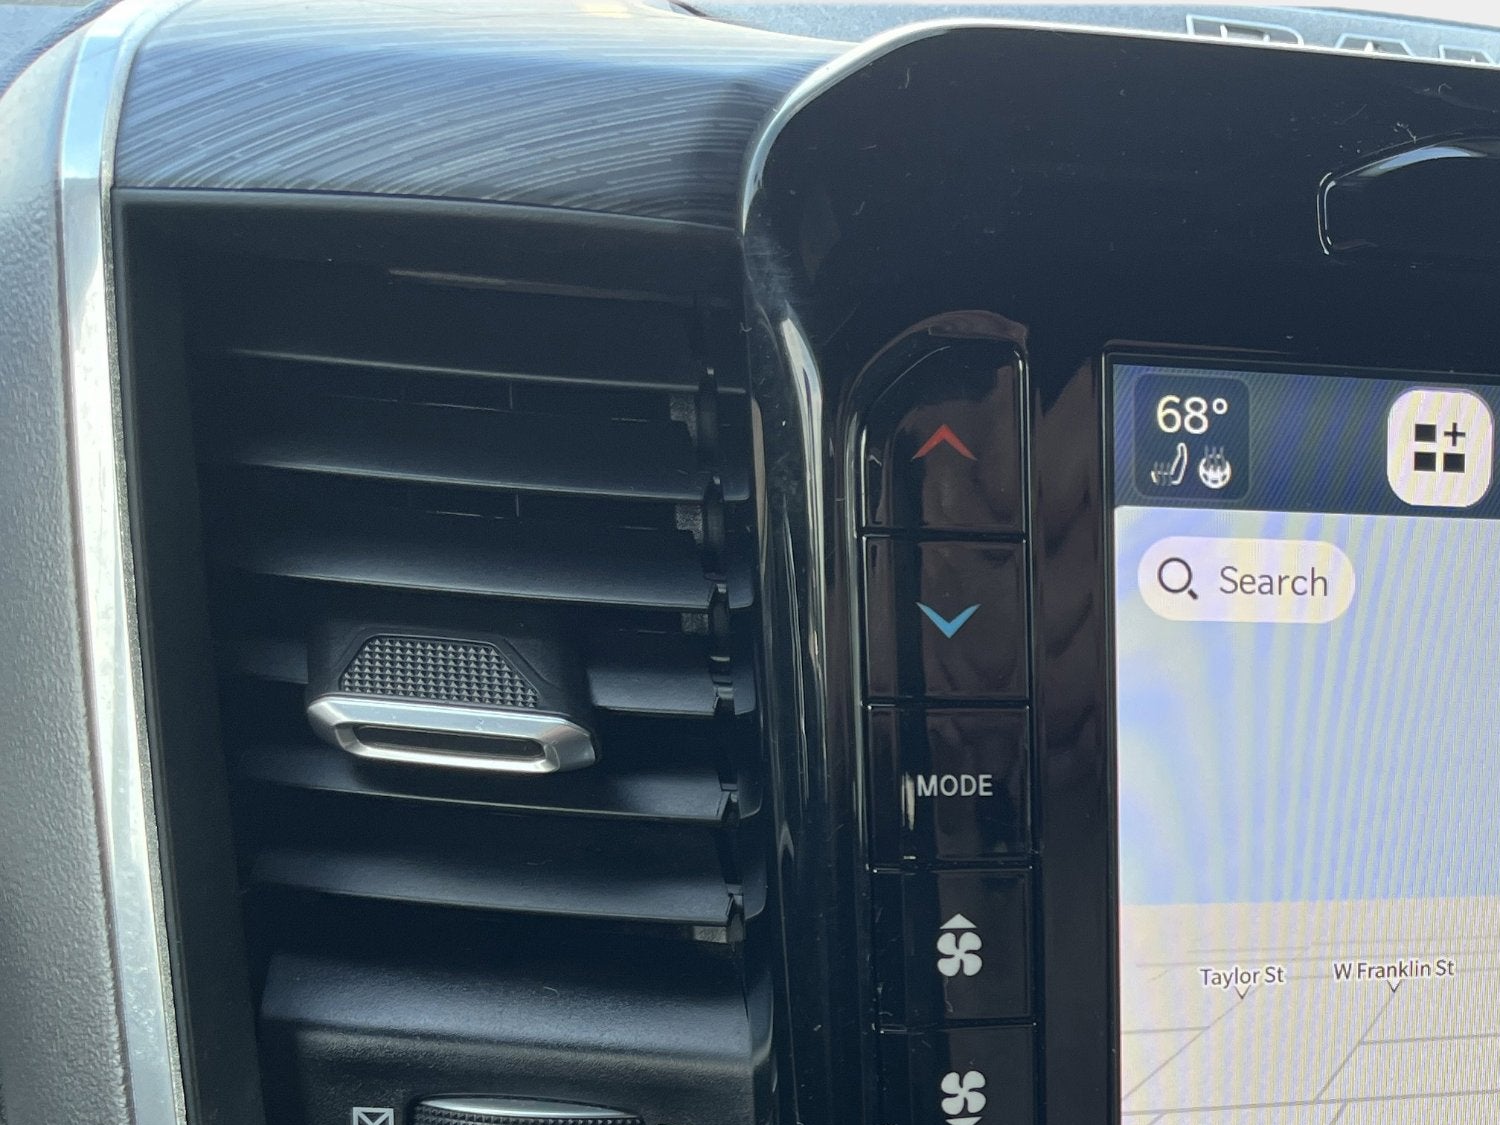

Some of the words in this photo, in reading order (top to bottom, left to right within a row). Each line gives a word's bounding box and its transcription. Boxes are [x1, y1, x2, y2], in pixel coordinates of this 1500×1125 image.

[1156, 395, 1228, 434] 68°
[1219, 565, 1328, 597] Search
[917, 774, 993, 797] MODE
[1200, 967, 1260, 989] Taylor
[1264, 966, 1284, 984] St
[1333, 963, 1352, 980] W
[1357, 960, 1429, 979] Franklin
[1431, 959, 1455, 977] St
